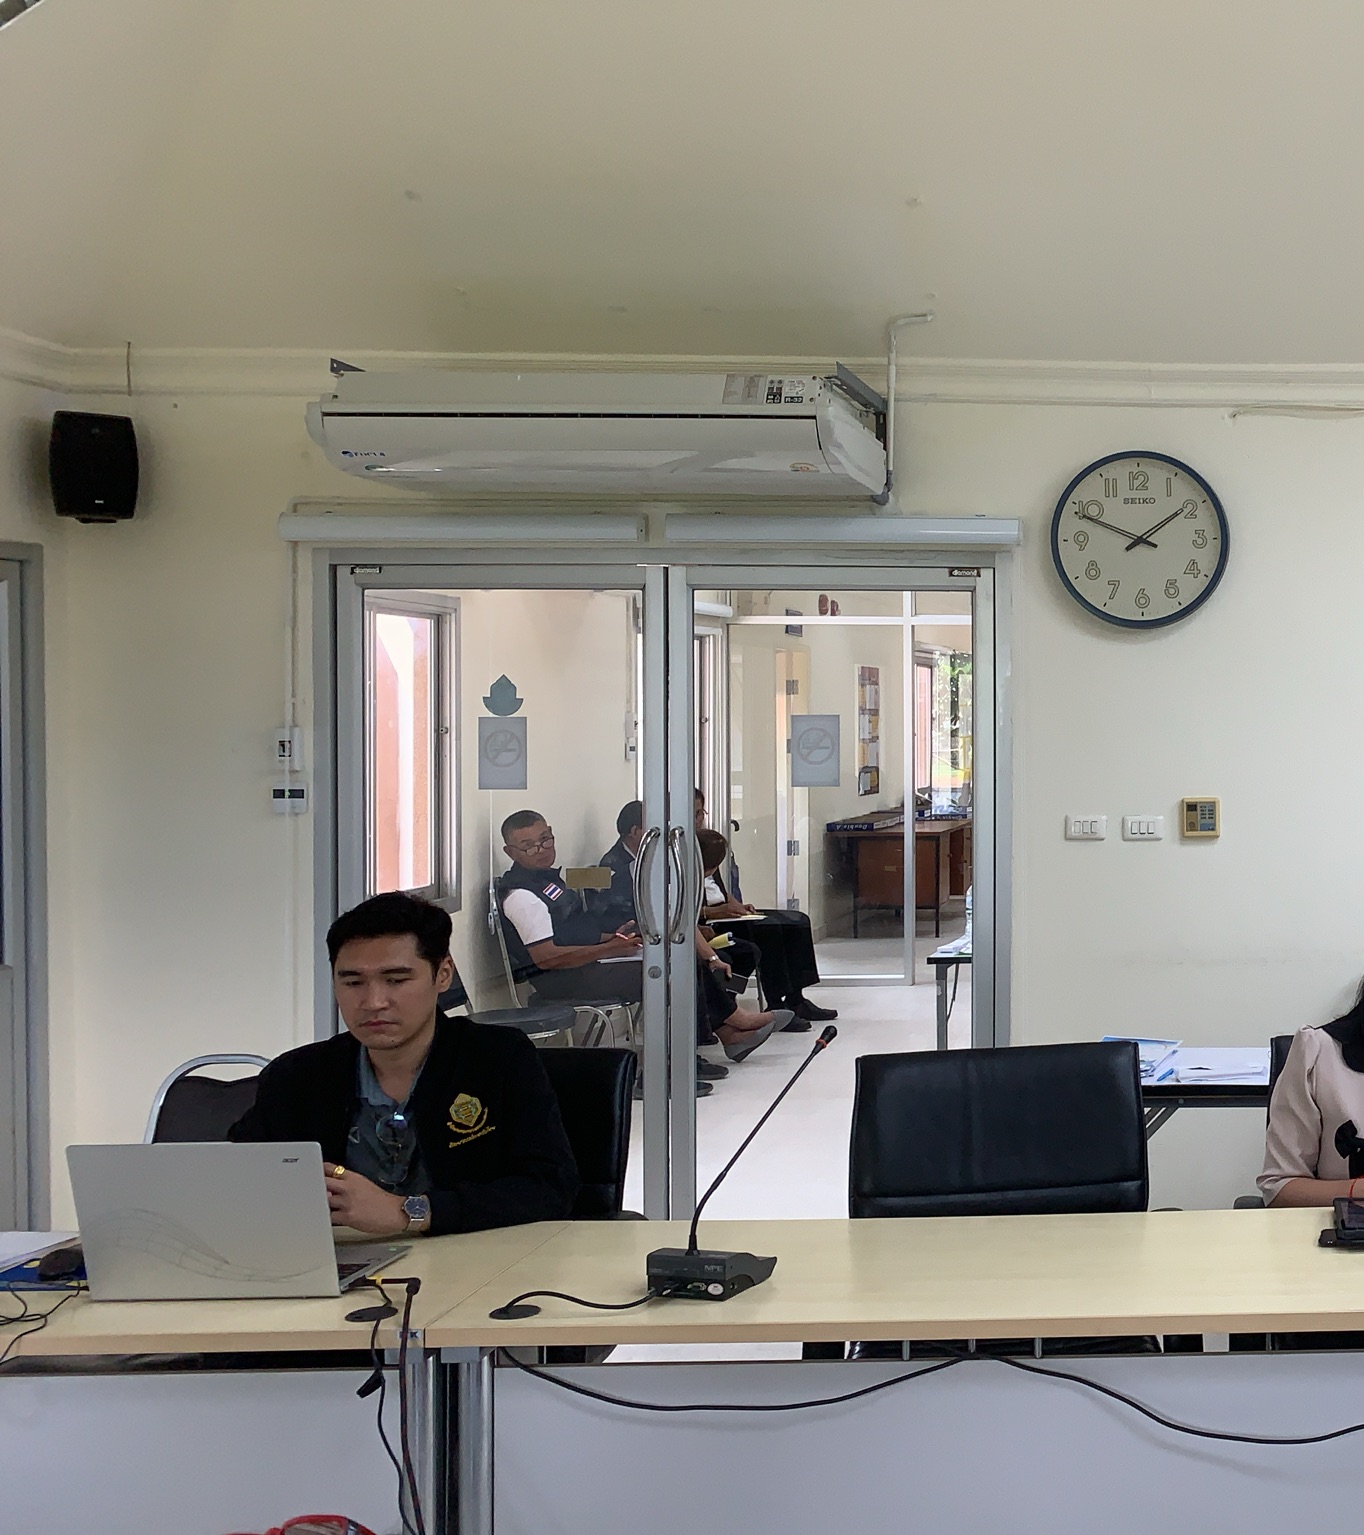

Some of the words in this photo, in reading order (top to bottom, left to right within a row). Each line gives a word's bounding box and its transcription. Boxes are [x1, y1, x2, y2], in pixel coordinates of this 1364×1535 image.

[1104, 478, 1118, 498] 11
[1128, 471, 1149, 491] 12
[1166, 477, 1172, 497] 1
[1078, 500, 1104, 520] 10
[1122, 497, 1156, 505] SEIKO
[1182, 499, 1198, 519] 2
[1073, 531, 1089, 551] 9
[1192, 529, 1207, 549] 3
[1085, 560, 1101, 580] 8
[1183, 559, 1201, 578] 4
[1107, 580, 1120, 600] 7
[1134, 588, 1150, 608] 6
[1164, 579, 1179, 599] 5
[704, 1264, 723, 1272] NPE
